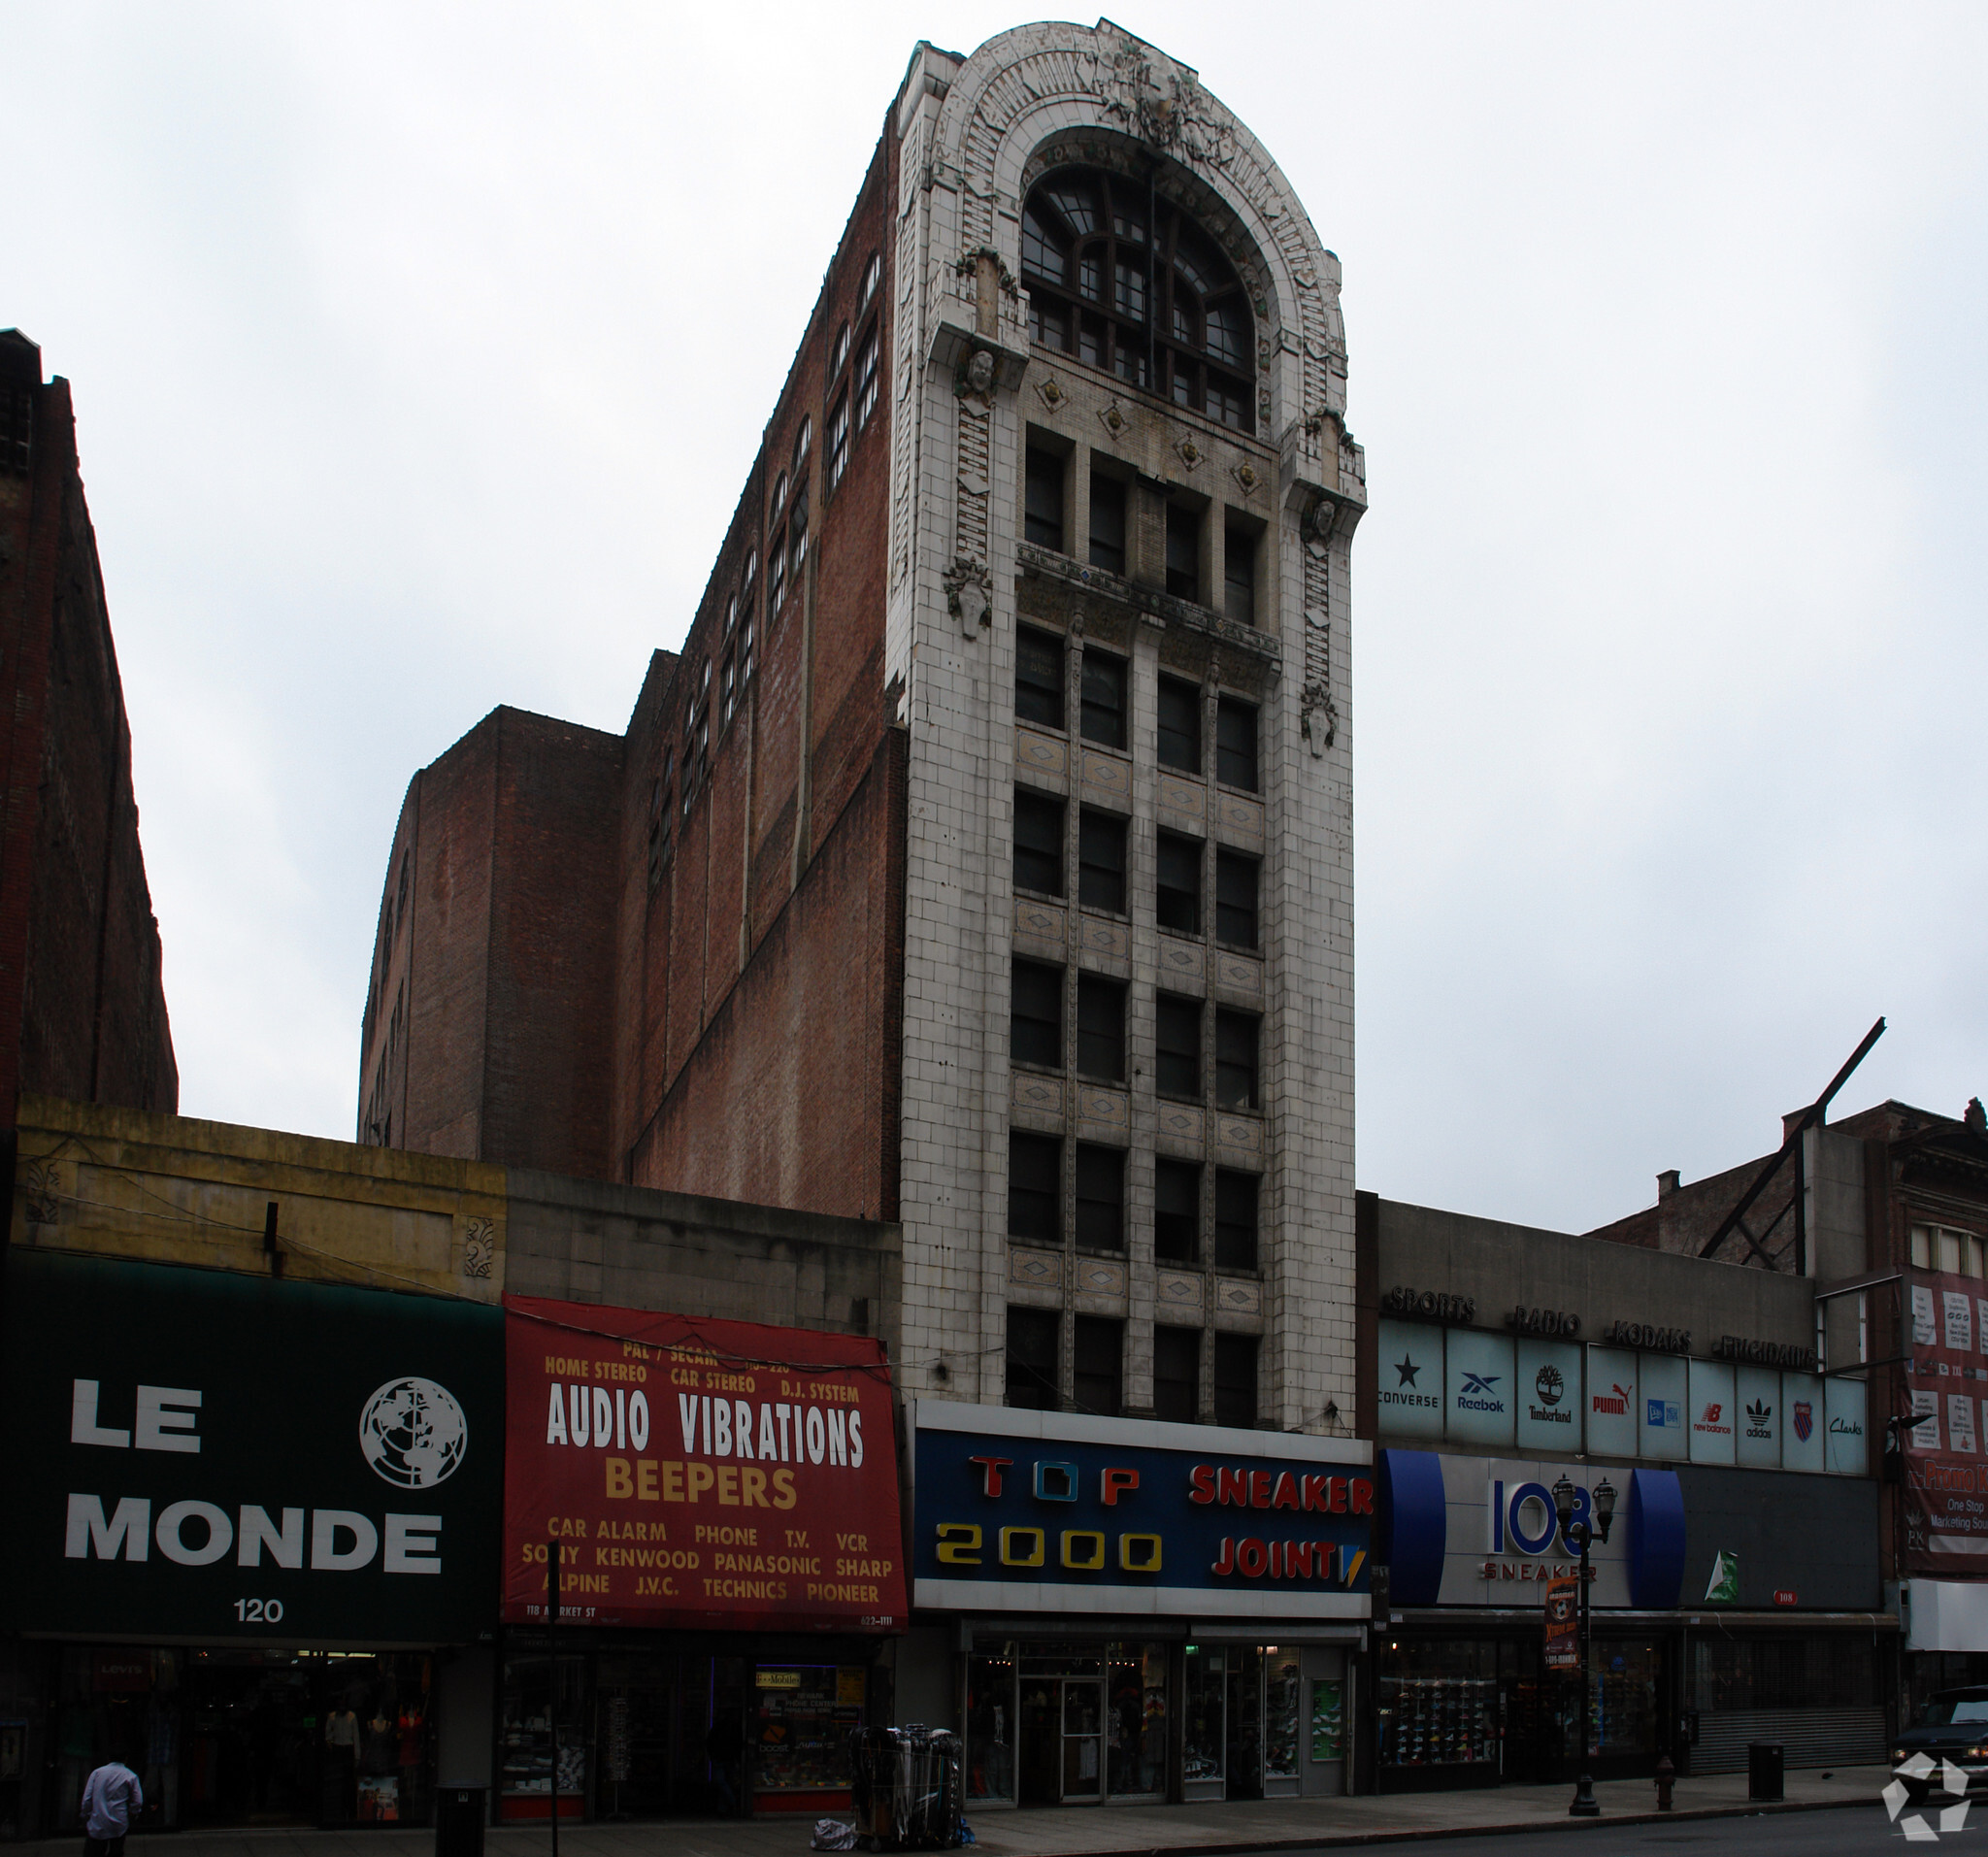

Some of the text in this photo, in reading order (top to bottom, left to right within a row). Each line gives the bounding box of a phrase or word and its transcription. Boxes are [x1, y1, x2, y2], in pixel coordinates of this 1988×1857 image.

[1391, 1286, 1475, 1321] SPORTS
[1516, 1306, 1580, 1337] RADIO
[1614, 1320, 1692, 1352] KODAKS
[623, 1342, 649, 1360] PAL
[670, 1344, 718, 1367] SECAM
[546, 1356, 860, 1404] HOME STEREO CAR STEREO D.J. SYSTEM
[1378, 1391, 1439, 1408] CONVERSE
[1458, 1397, 1504, 1412] Reebok
[1529, 1405, 1572, 1423] Timberland
[1593, 1396, 1625, 1414] PUMA
[71, 1378, 202, 1453] LE
[546, 1382, 864, 1469] AUDIO VIBRATIONS
[1694, 1423, 1731, 1435] new balance
[1829, 1417, 1863, 1435] Clarks
[1746, 1428, 1772, 1439] adidas
[606, 1457, 798, 1510] BEEPERS
[968, 1455, 1141, 1507] TOP
[1188, 1464, 1375, 1515] SNEAKER
[1925, 1459, 1975, 1493] Promo
[1488, 1480, 1591, 1557] 108
[1947, 1498, 1984, 1514] One Stop
[64, 1493, 443, 1575] MONDE
[547, 1516, 868, 1552] CAR ALARM PHONE T.V. VCR
[1931, 1514, 1971, 1531] Marketing
[596, 1547, 700, 1570] KENWOOD
[714, 1552, 821, 1575] PANASONIC
[836, 1557, 893, 1577] SHARP
[935, 1521, 1163, 1573] 2000
[1210, 1536, 1336, 1579] JOINT
[636, 1576, 679, 1597] J.V.C.
[704, 1577, 787, 1600] TECHNICS
[808, 1582, 879, 1604] PIONEER
[1779, 1592, 1793, 1603] 108
[234, 1599, 283, 1623] 120
[527, 1604, 596, 1618] 118 MRKET ST
